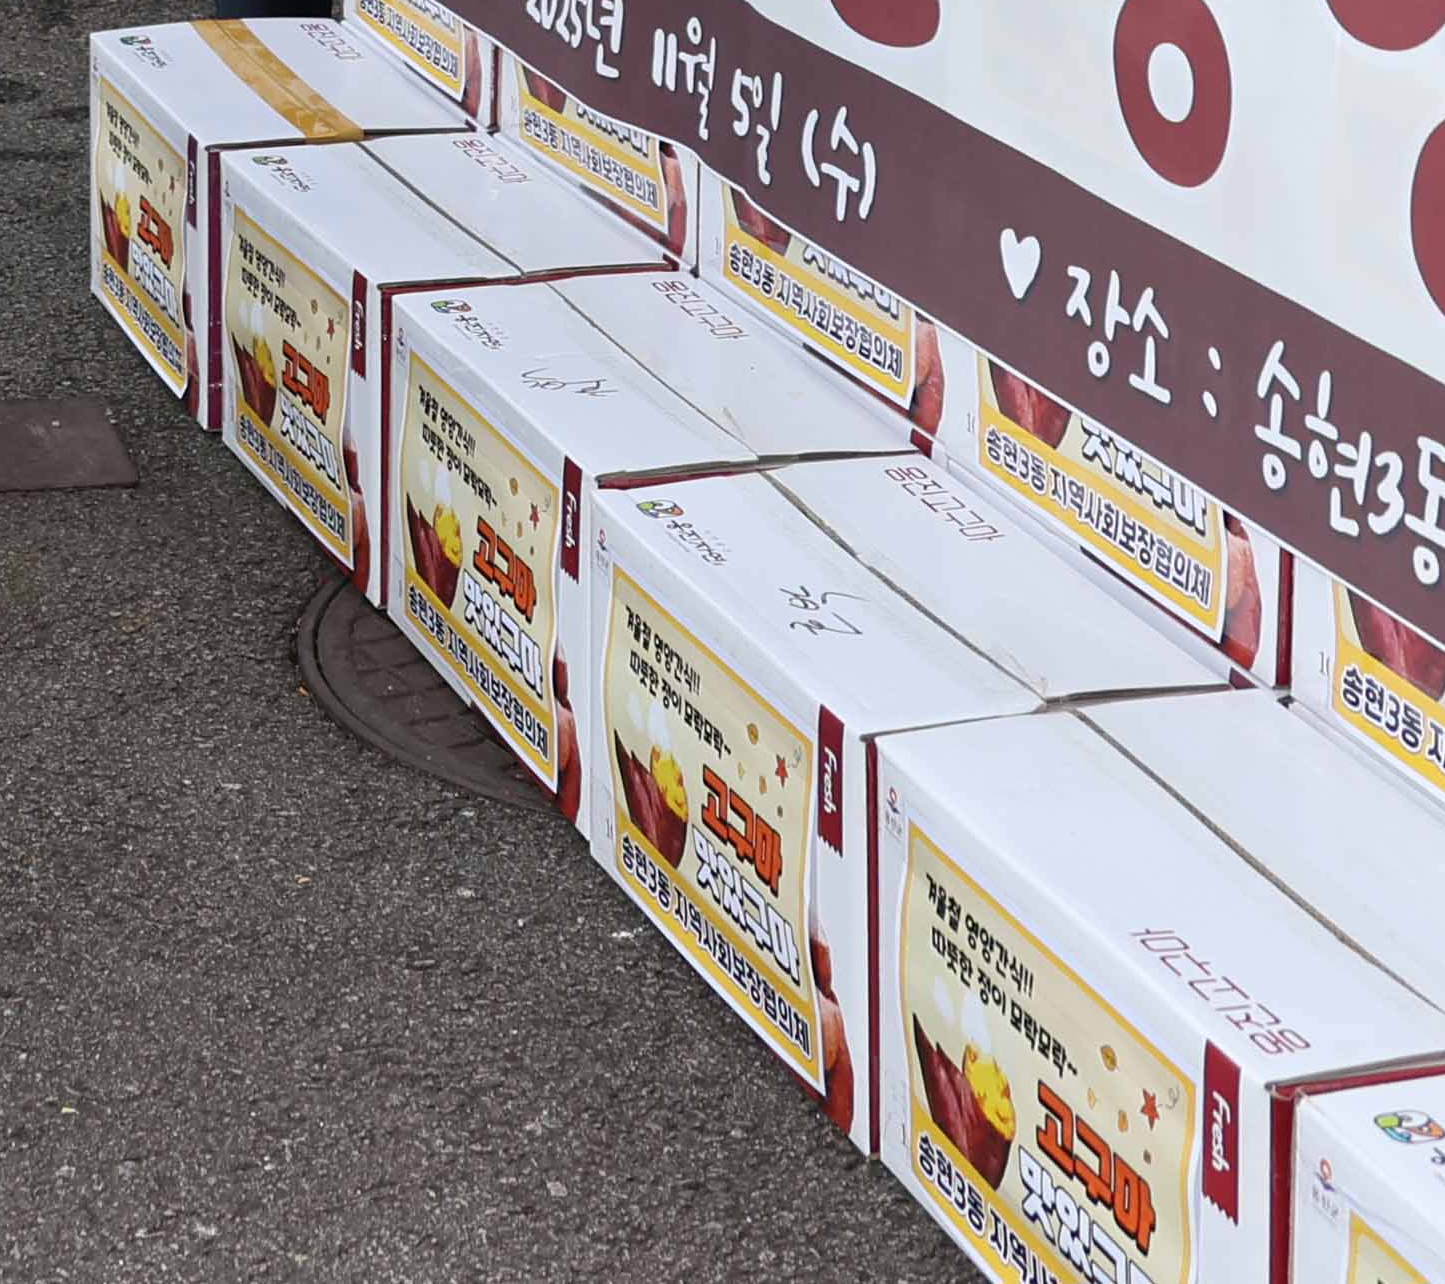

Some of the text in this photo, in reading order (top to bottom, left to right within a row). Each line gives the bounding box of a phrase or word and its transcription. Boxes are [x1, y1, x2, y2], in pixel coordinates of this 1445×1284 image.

[523, 107, 559, 150] 송현3동
[560, 128, 659, 210] 지역사회보장협의체
[652, 17, 716, 141] 11월
[731, 68, 783, 185] 5일
[802, 107, 877, 222] (수)
[137, 194, 174, 270] 고구마
[729, 242, 775, 296] 송현3동
[775, 271, 903, 381] 지역사회보장협의체
[1065, 264, 1172, 408] 장소
[282, 339, 331, 427] 고구마
[278, 386, 342, 491] 맛있구마
[473, 515, 538, 625] 고구마
[564, 490, 578, 549] Fresh
[986, 428, 1211, 608] 송현3동 지역사회보장협의체
[408, 583, 549, 760] 송현3동 지역사회보장협의체
[462, 567, 544, 701] 맛있구마
[625, 604, 652, 651] 겨울철
[629, 649, 659, 698] 따뜻한
[661, 677, 682, 715] 정이
[1341, 666, 1425, 750] 송현3동
[701, 763, 784, 898] 고구마
[823, 748, 838, 815] Fresh
[622, 834, 810, 1057] 송현3동 지역사회보장협의체
[691, 823, 802, 987] 맛있구마
[926, 872, 961, 933] 겨울철
[932, 925, 973, 989] 따뜻한
[977, 967, 1007, 1016] 정이
[1036, 1079, 1157, 1257] 고구마
[1212, 1090, 1232, 1173] Fresh
[918, 1134, 985, 1235] 송현3동
